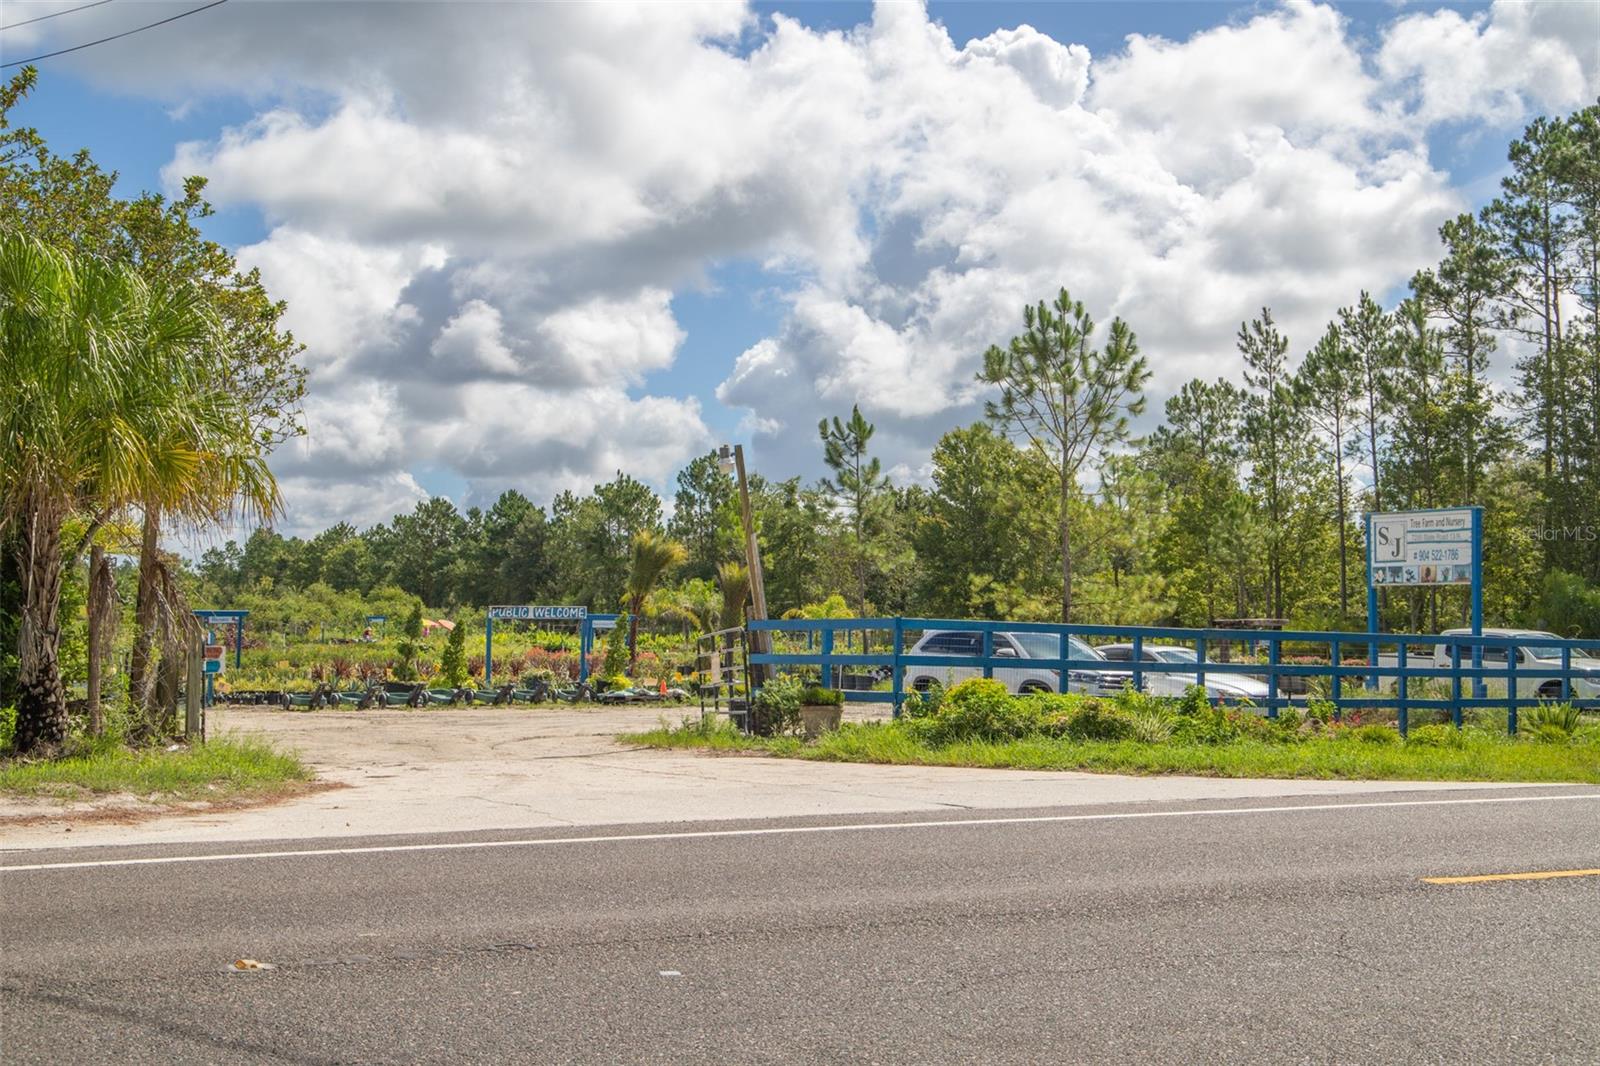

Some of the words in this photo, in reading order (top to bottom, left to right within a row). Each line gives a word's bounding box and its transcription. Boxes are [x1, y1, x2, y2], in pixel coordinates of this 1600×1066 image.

[1422, 518, 1434, 528] Farm
[1435, 517, 1445, 527] and
[1446, 516, 1465, 528] Nursery
[1378, 526, 1389, 545] S
[1391, 537, 1401, 558] J
[1419, 550, 1430, 561] 904
[1431, 549, 1459, 560] 522-1786
[492, 607, 528, 617] PUBLIC
[534, 607, 585, 618] WELCOME
